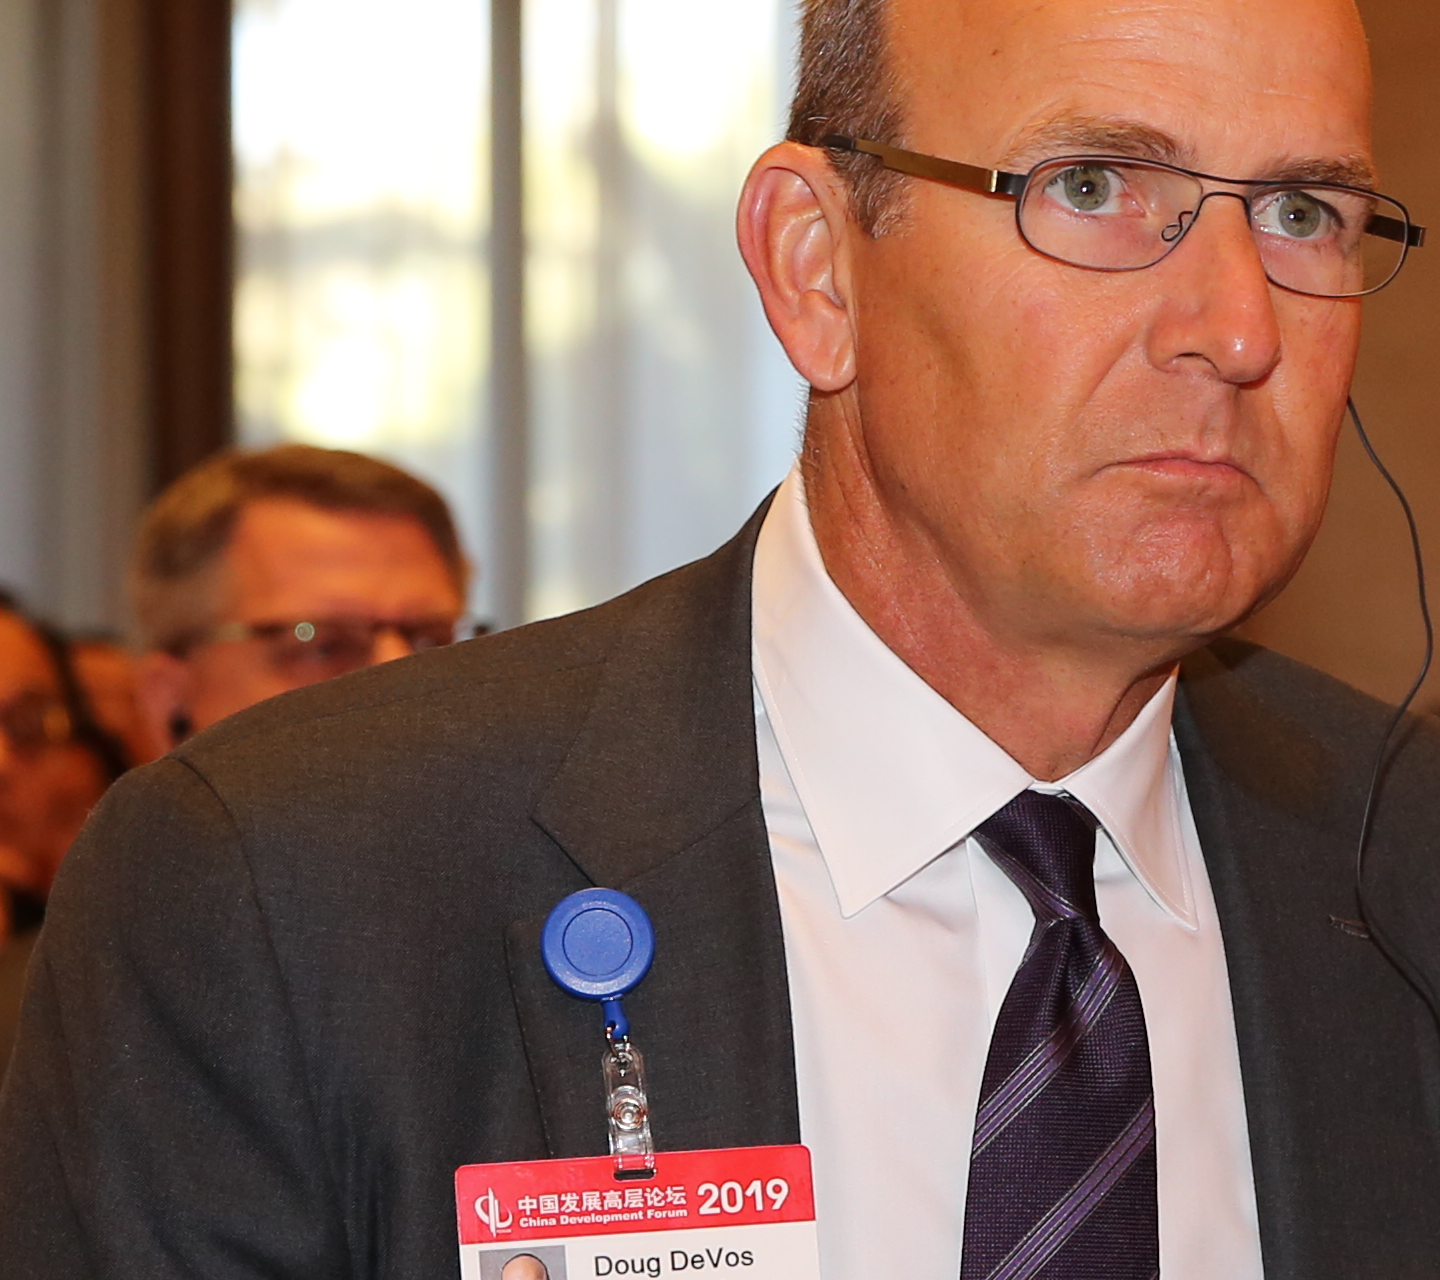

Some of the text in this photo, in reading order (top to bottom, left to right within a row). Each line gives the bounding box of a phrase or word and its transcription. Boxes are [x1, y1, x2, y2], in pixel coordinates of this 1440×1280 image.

[517, 1178, 790, 1216] 中国发展高层论坛 2019
[519, 1207, 688, 1229] China Development Forum
[594, 1246, 754, 1278] Doug DeVos
